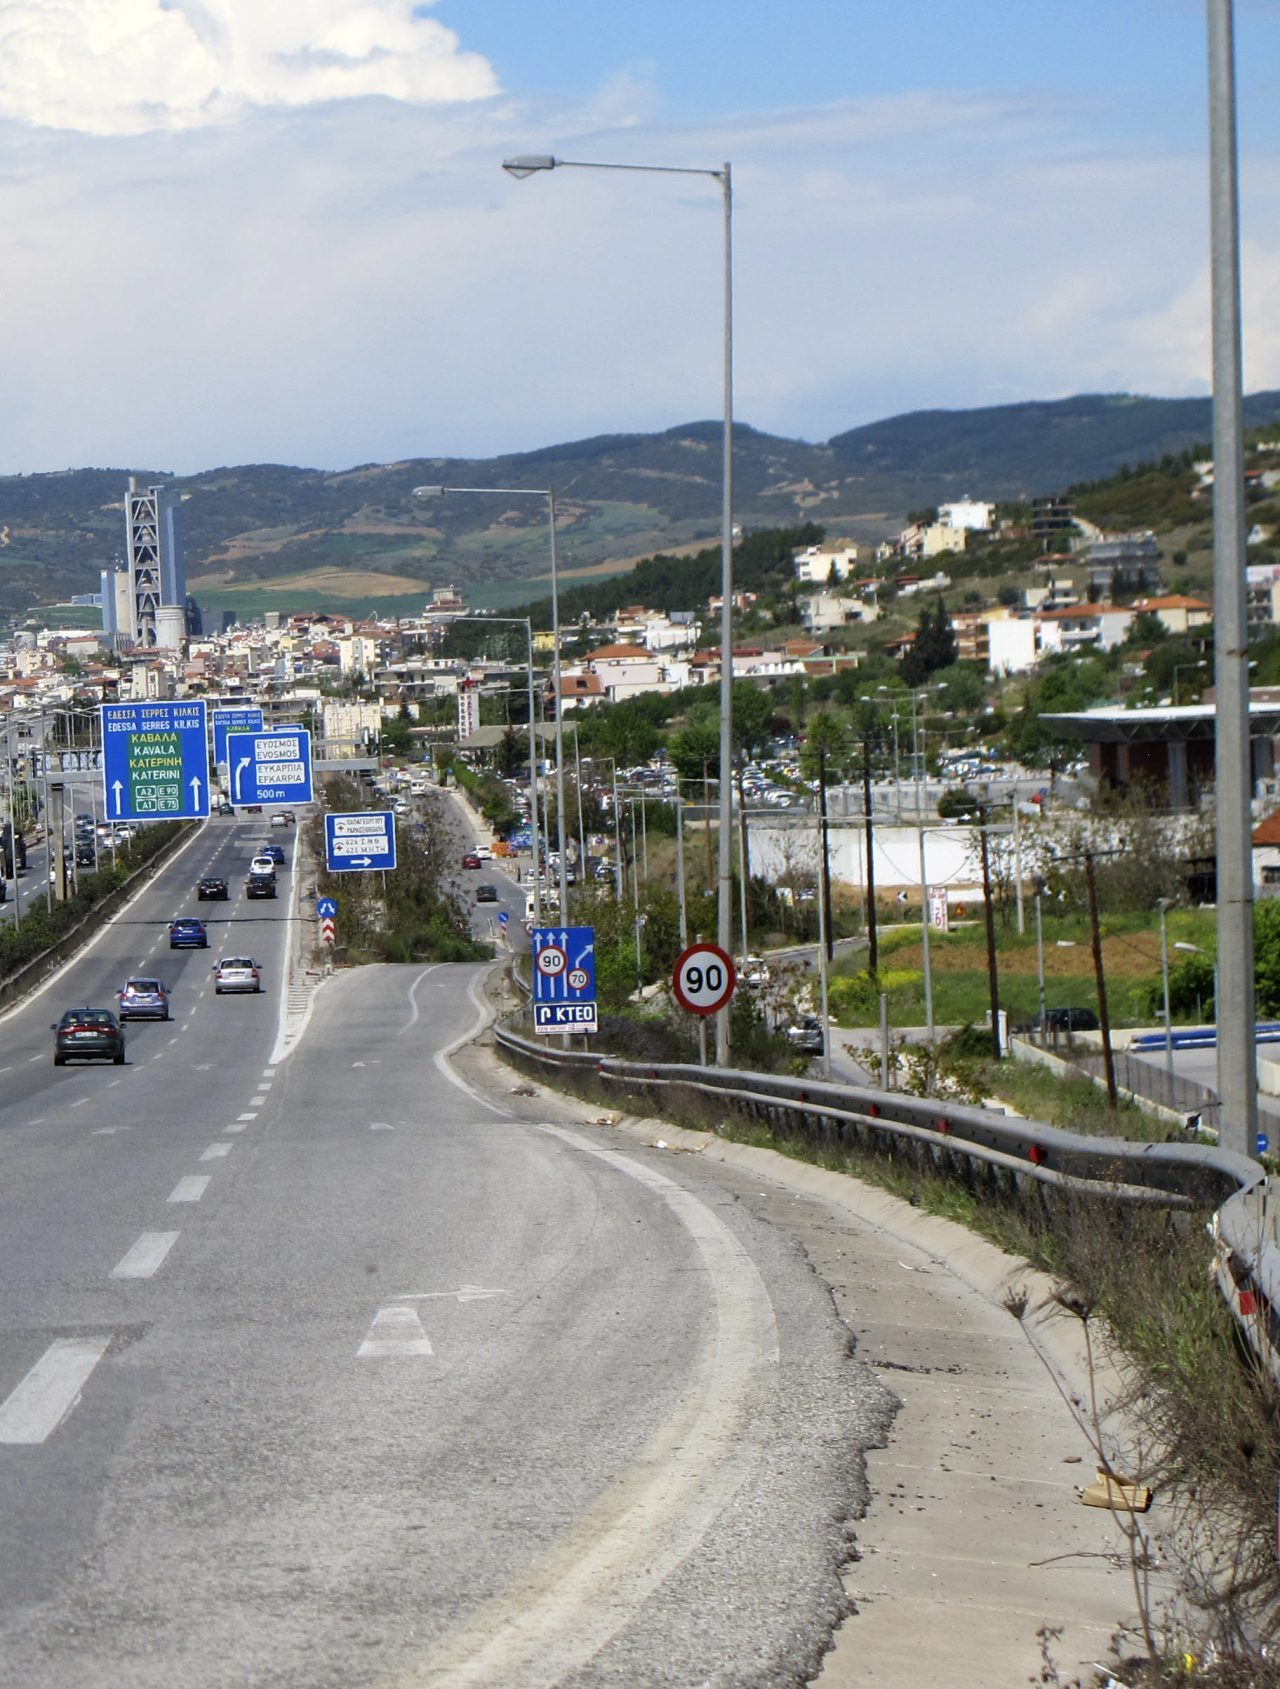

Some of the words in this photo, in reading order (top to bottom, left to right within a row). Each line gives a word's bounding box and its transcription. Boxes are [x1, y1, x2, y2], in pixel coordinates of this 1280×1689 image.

[107, 710, 136, 719] ΕΔΕΣΣΑ
[141, 708, 169, 718] ΣΕΡΡΕΣ
[173, 707, 200, 717] ΚΙΛΚΙΣ
[108, 722, 137, 732] EDESSA
[141, 720, 170, 731] SERRES
[174, 719, 200, 729] KILKIS
[131, 732, 177, 743] ΚΑΒΑΛΑ
[256, 740, 297, 749] ΕΥΟΣΜΟΣ
[134, 745, 176, 756] KAVALA
[257, 750, 298, 759] EVOSMOS
[129, 757, 182, 768] ΚΑΤΕΡΙΝΗ
[257, 764, 302, 774] ΕΥΚΑΡΠΙΑ
[132, 770, 180, 781] KATERINI
[258, 774, 302, 783] EFKARPIA
[140, 788, 152, 796] A2
[142, 801, 152, 809] A1
[543, 955, 561, 967] 90
[572, 974, 585, 983] 70
[686, 965, 722, 993] 90
